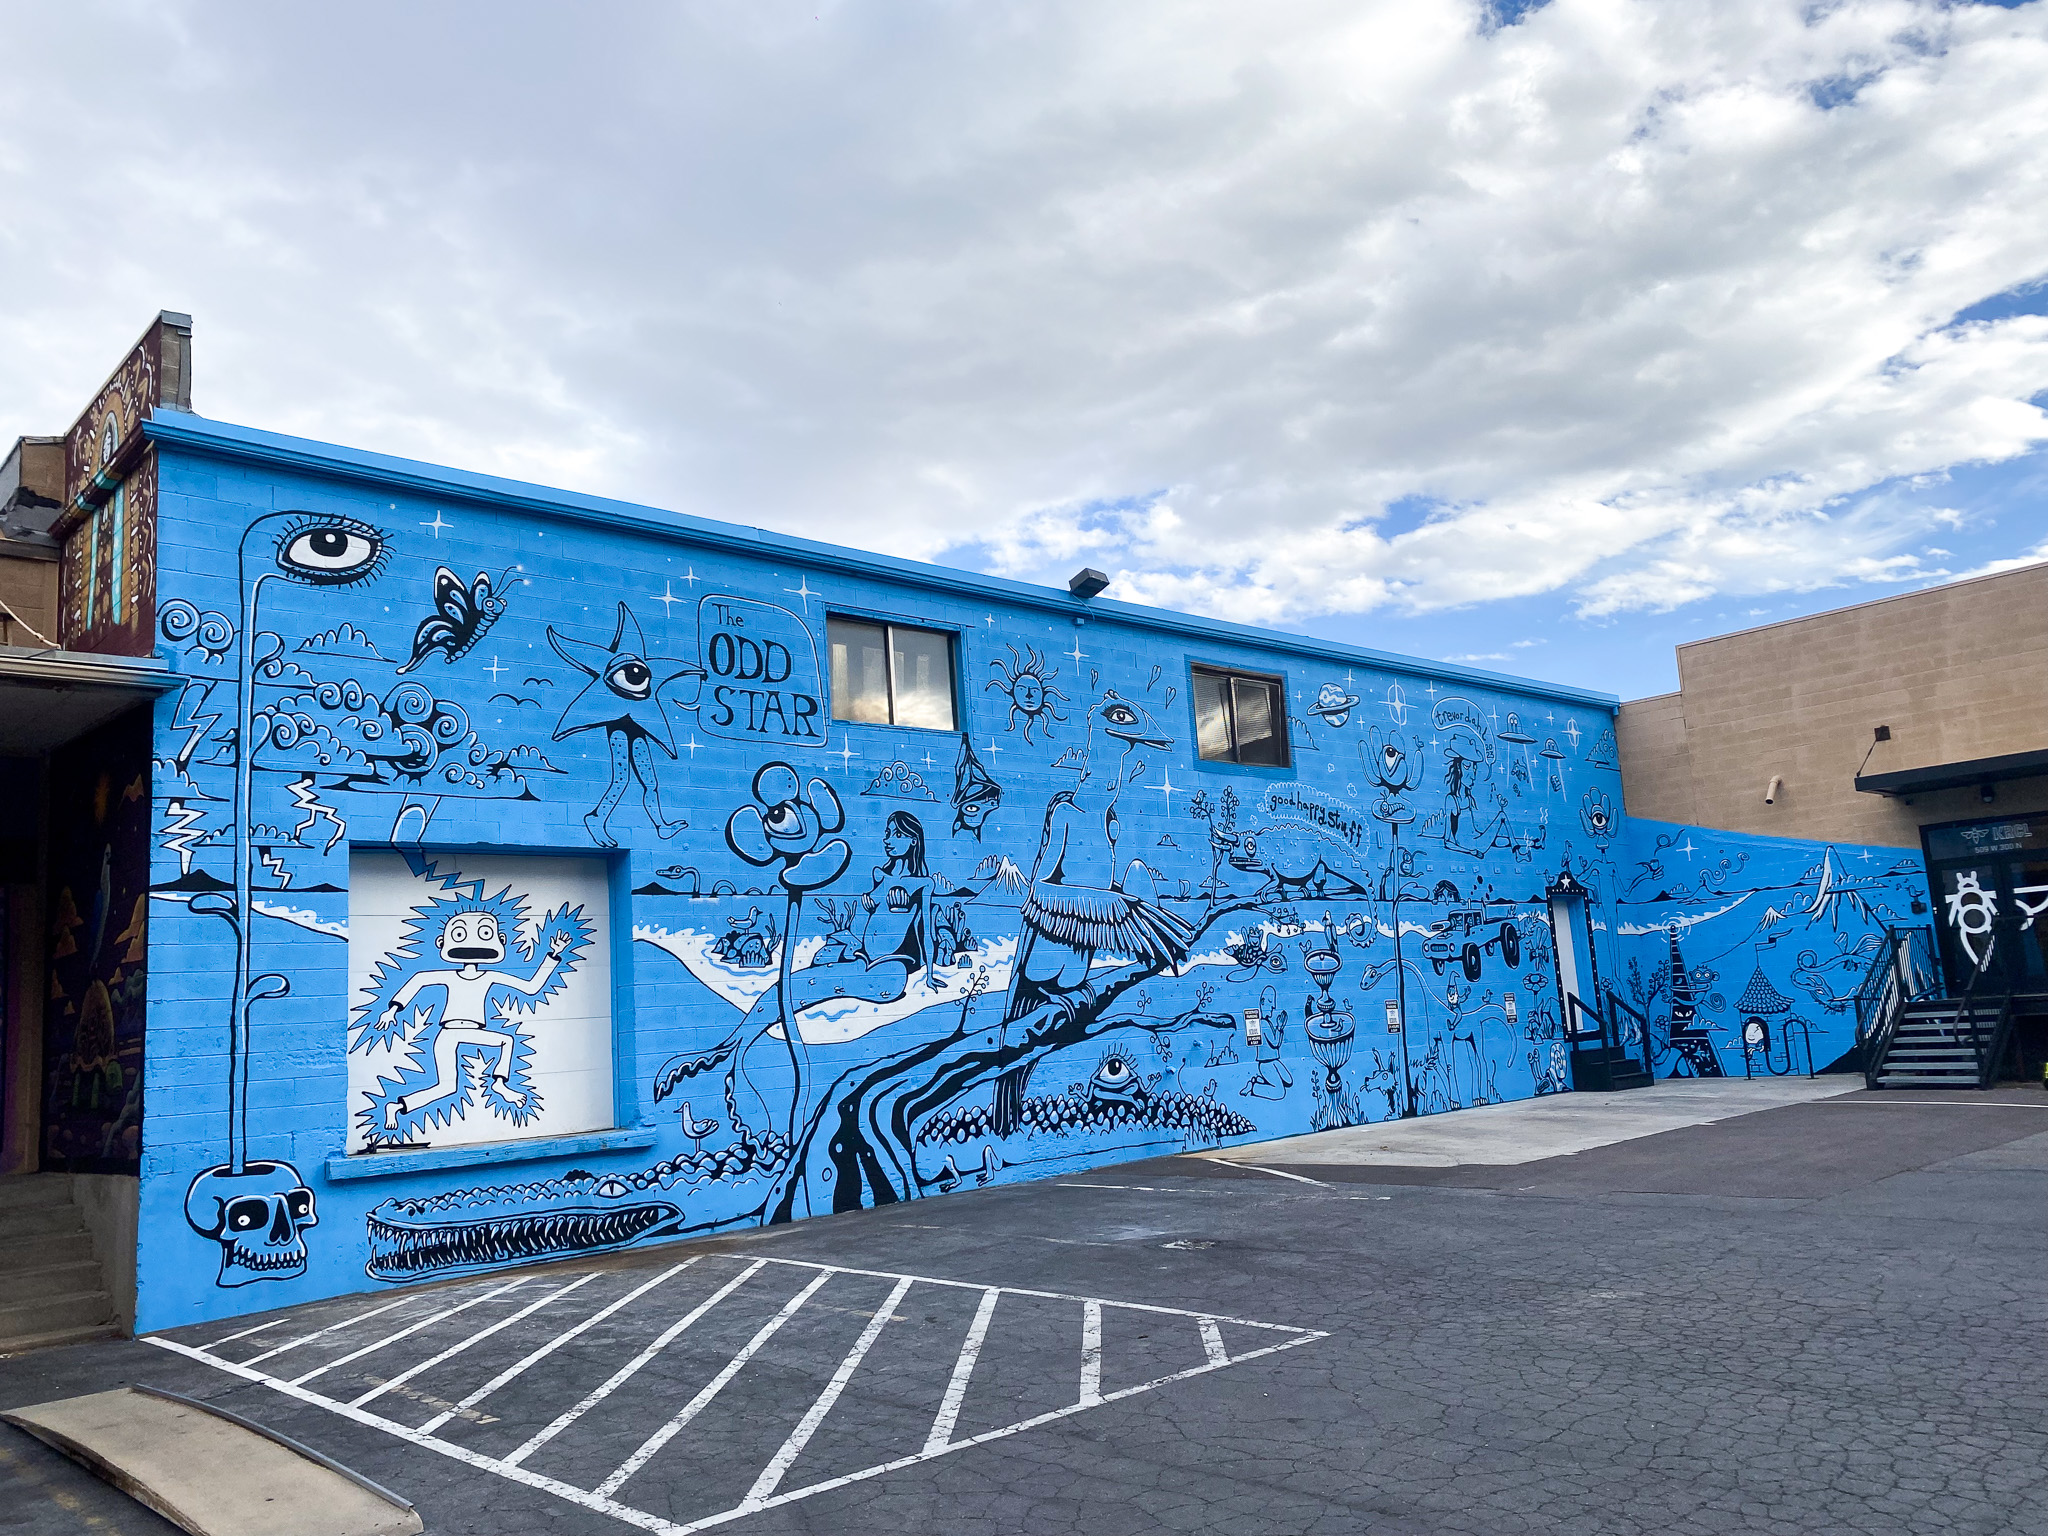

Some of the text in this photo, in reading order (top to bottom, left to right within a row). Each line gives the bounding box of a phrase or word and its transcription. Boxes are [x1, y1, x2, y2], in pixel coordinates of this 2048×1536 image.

[712, 603, 744, 627] The
[708, 632, 792, 683] ODD
[710, 685, 821, 738] STAR
[1435, 710, 1464, 726] trevor
[1270, 791, 1296, 812] good
[1296, 791, 1327, 826] happy
[1992, 823, 2033, 841] KRCL
